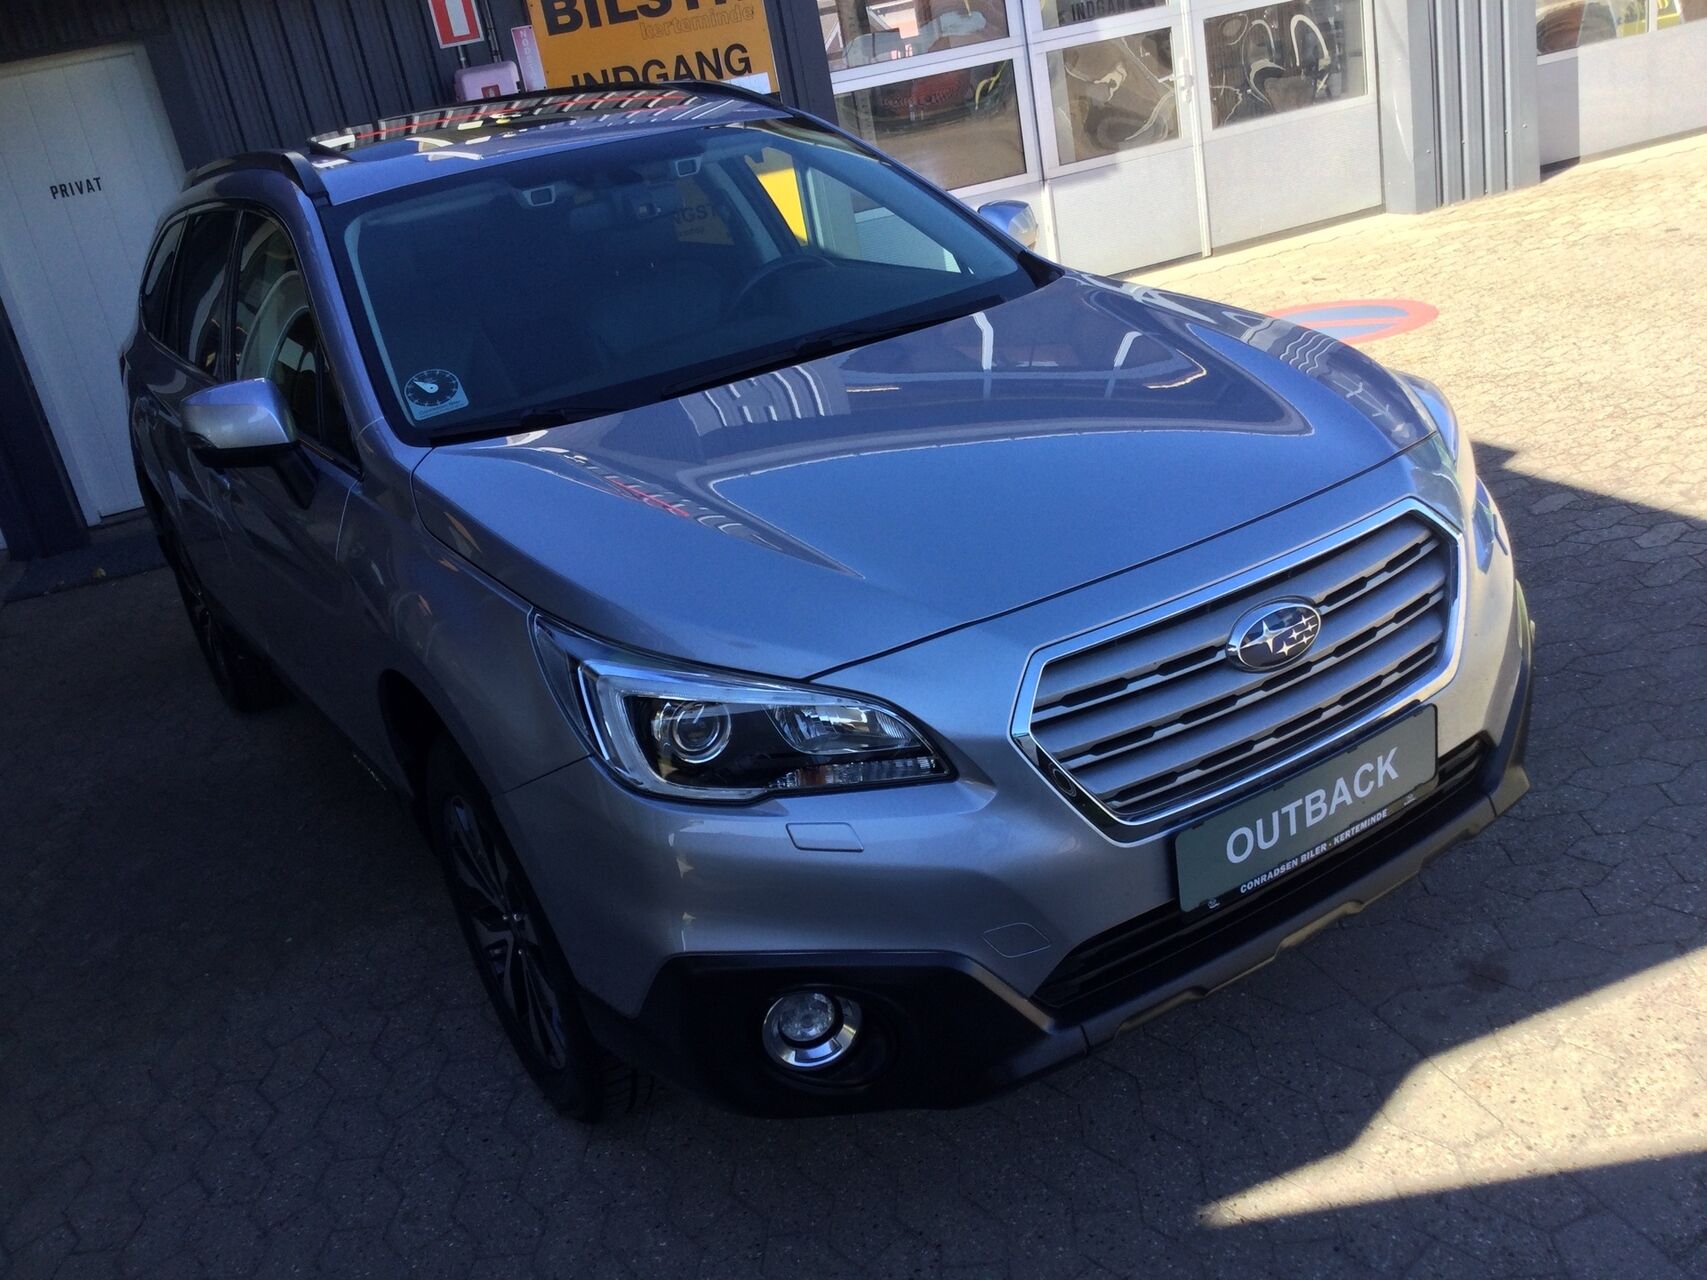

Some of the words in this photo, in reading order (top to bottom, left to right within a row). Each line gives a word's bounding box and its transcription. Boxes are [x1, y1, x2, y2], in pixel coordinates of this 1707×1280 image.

[541, 0, 742, 36] BILS
[640, 4, 755, 40] kerteminde
[50, 177, 103, 200] PRIVAT
[1226, 746, 1399, 864] OUTBACK
[1240, 857, 1298, 894] CONRADSEN
[1300, 843, 1327, 863] BILER
[1333, 808, 1388, 846] KERTEMINDE
